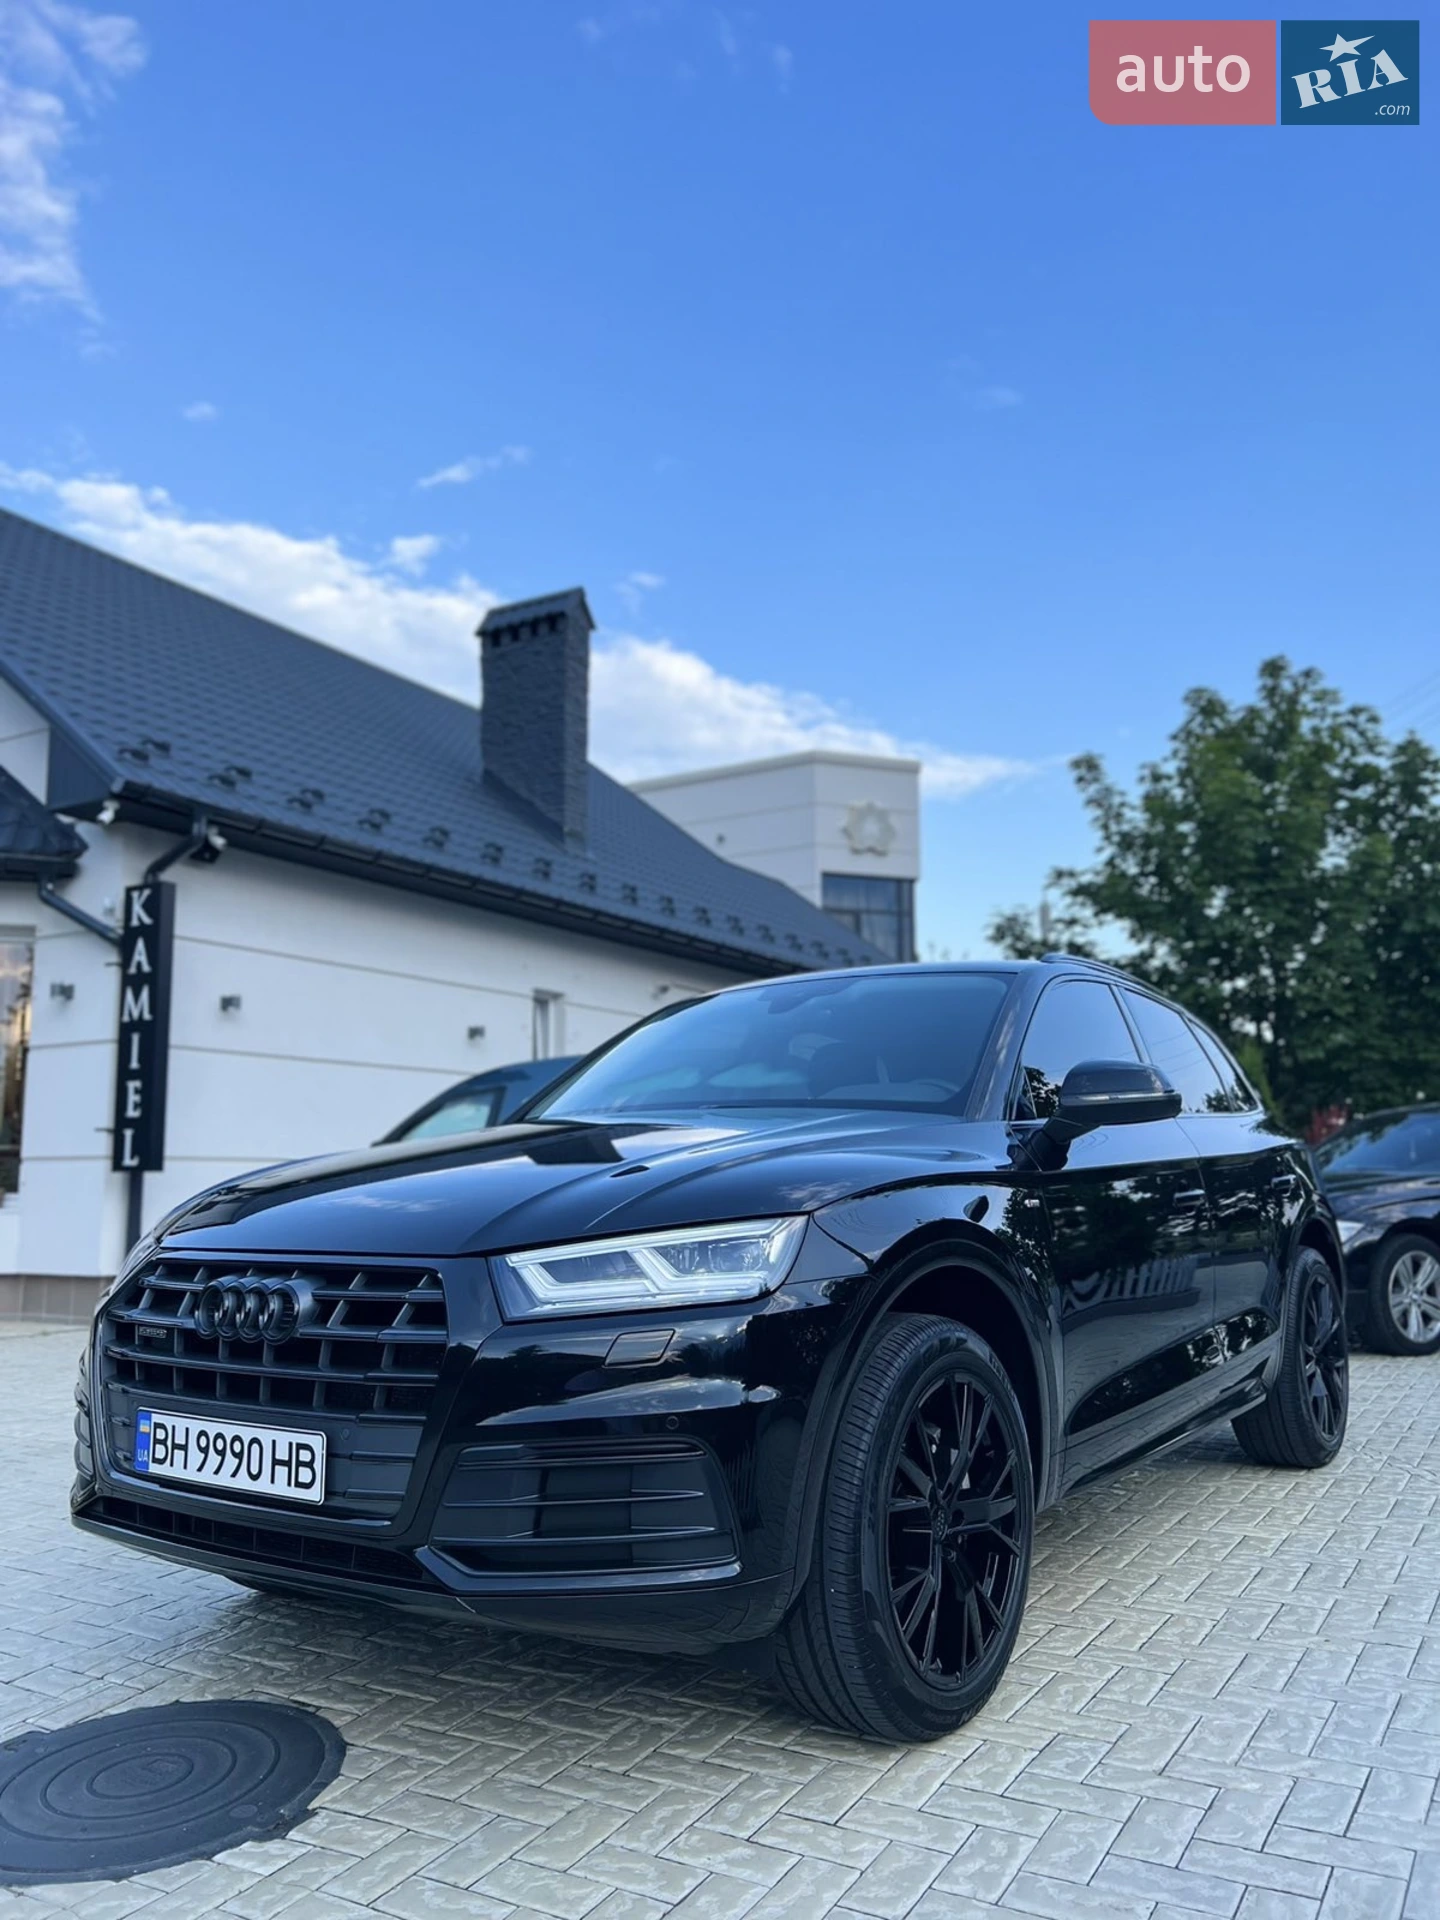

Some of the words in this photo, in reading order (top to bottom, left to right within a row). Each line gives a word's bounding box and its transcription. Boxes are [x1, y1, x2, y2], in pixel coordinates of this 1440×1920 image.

[121, 888, 154, 1167] KAMIEL
[137, 1448, 149, 1462] UA
[151, 1421, 190, 1470] BH
[196, 1429, 264, 1482] 9990
[270, 1438, 317, 1490] HB
